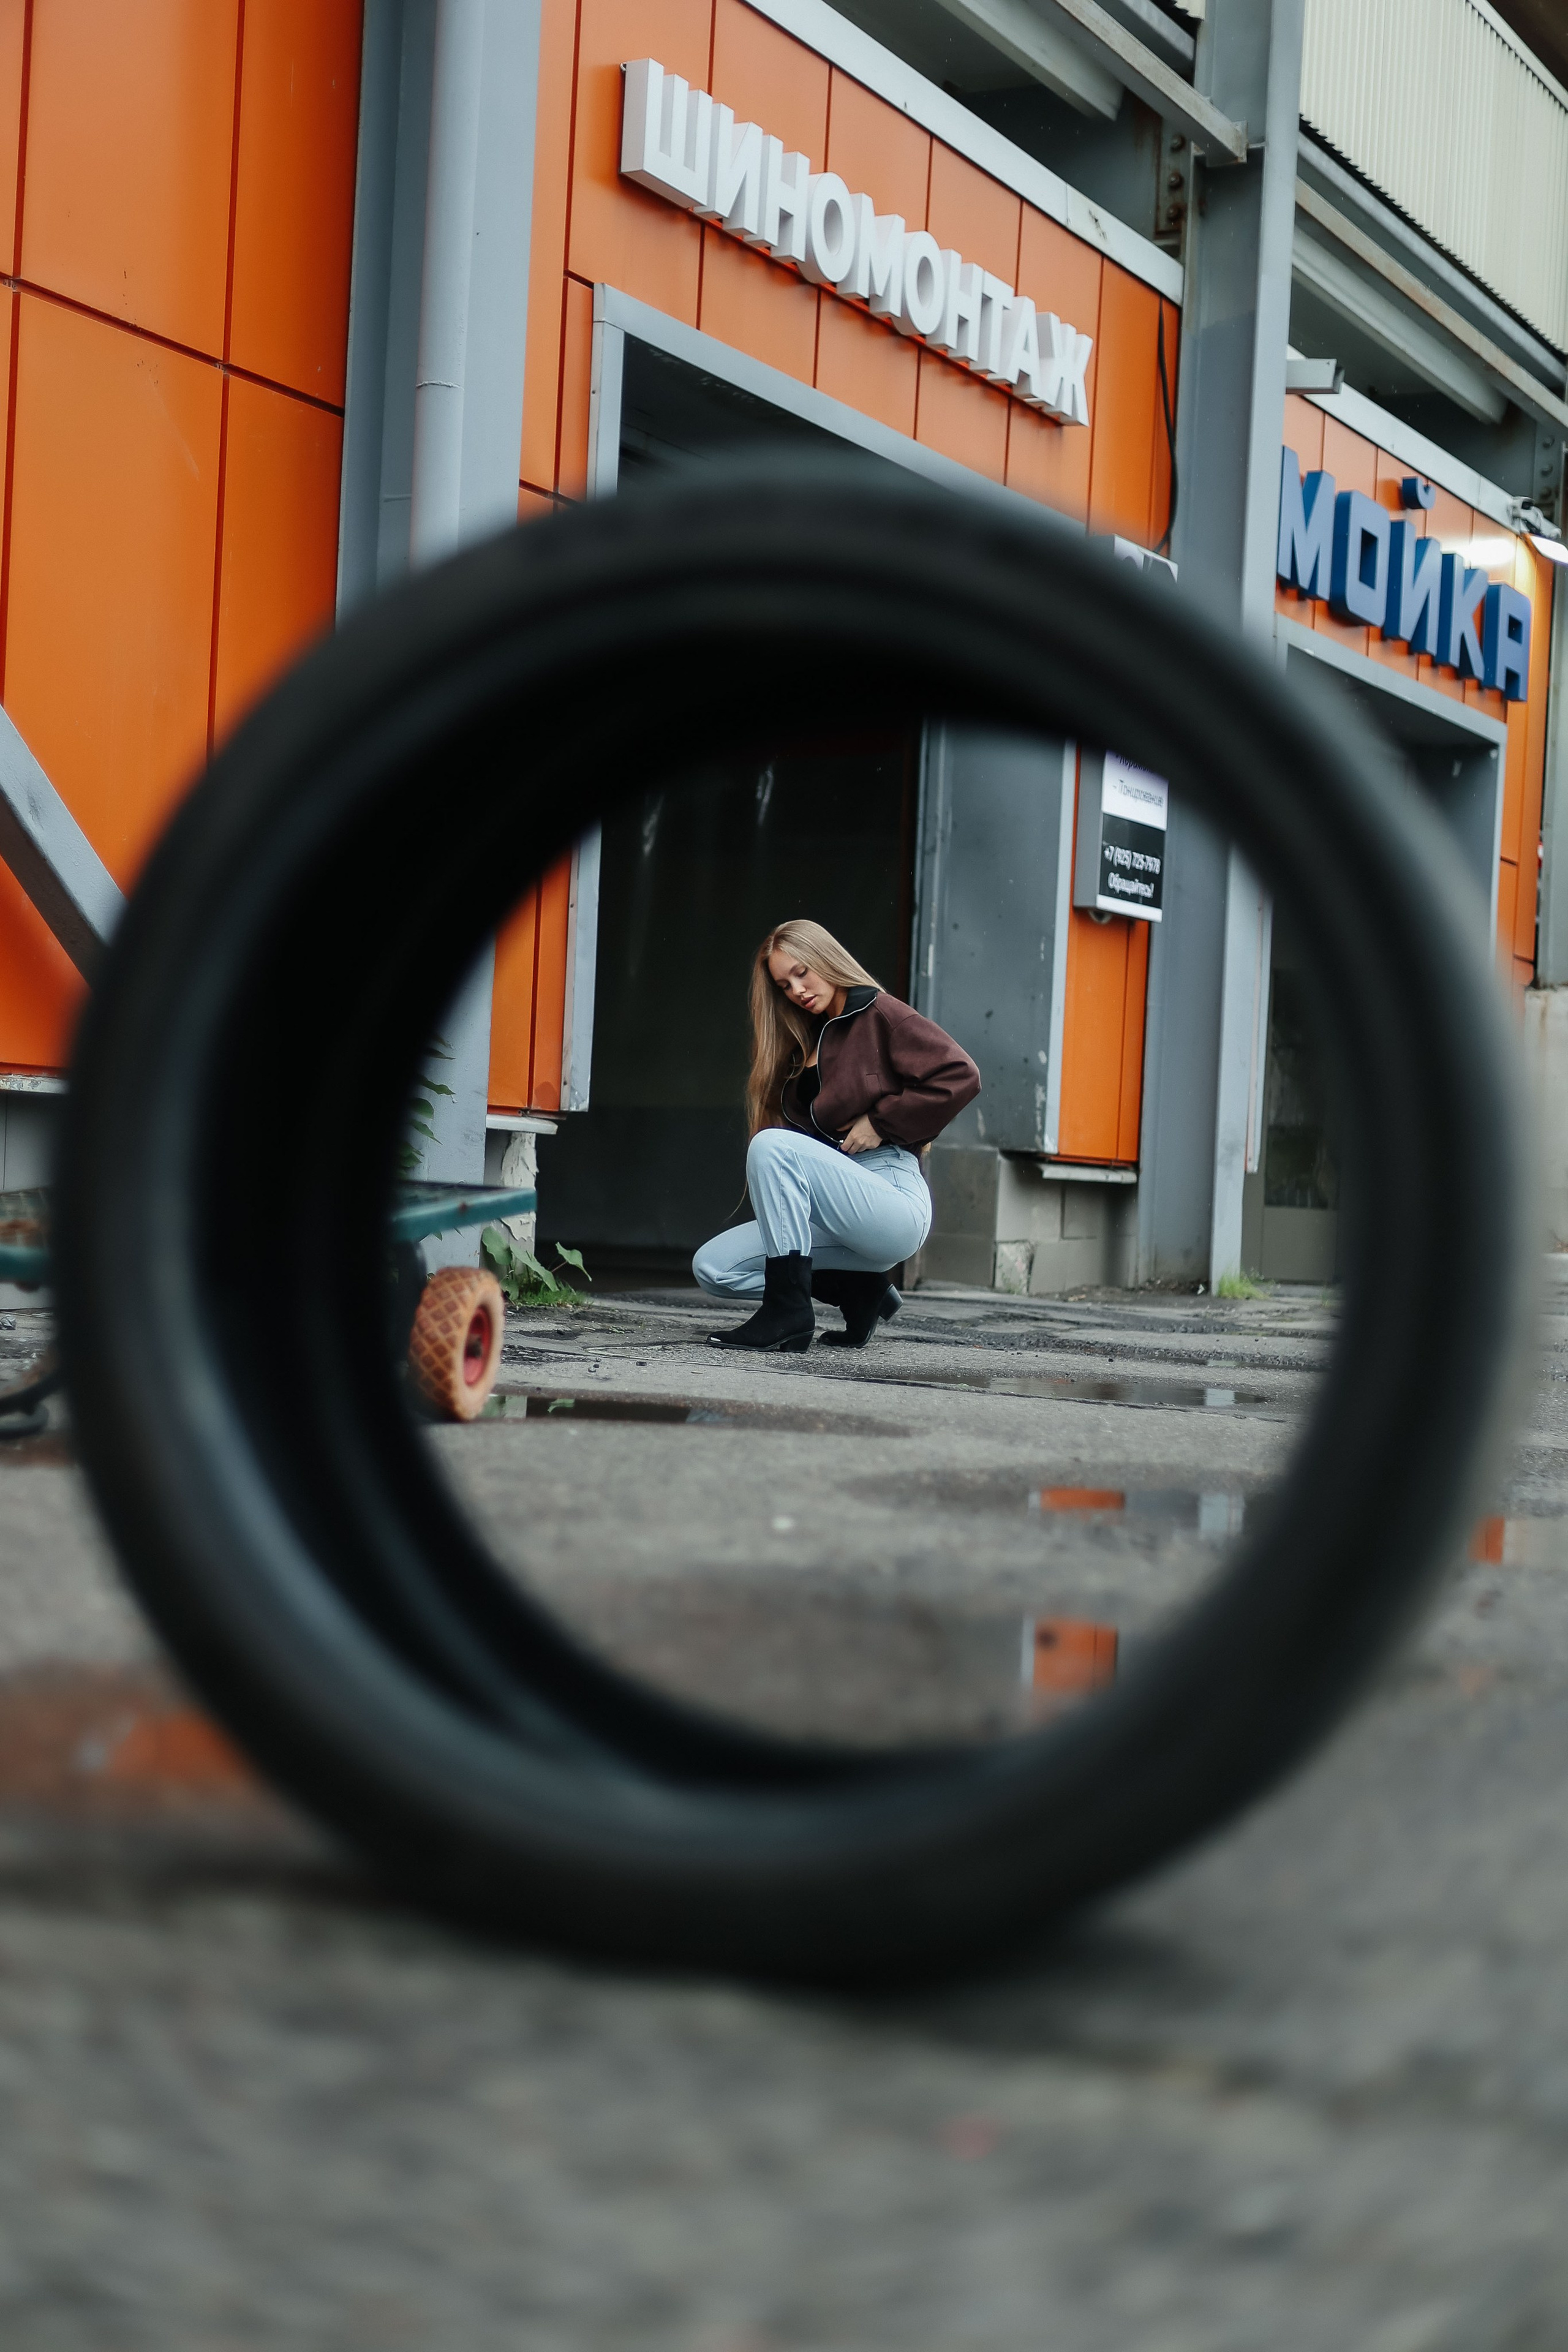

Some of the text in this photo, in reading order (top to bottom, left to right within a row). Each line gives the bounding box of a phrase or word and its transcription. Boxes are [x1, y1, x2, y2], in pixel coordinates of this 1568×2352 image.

[621, 58, 1093, 427] ШИНОМОНТАЖ
[1277, 445, 1531, 701] МОЙКА
[1107, 872, 1155, 899] Обращайтесь!
